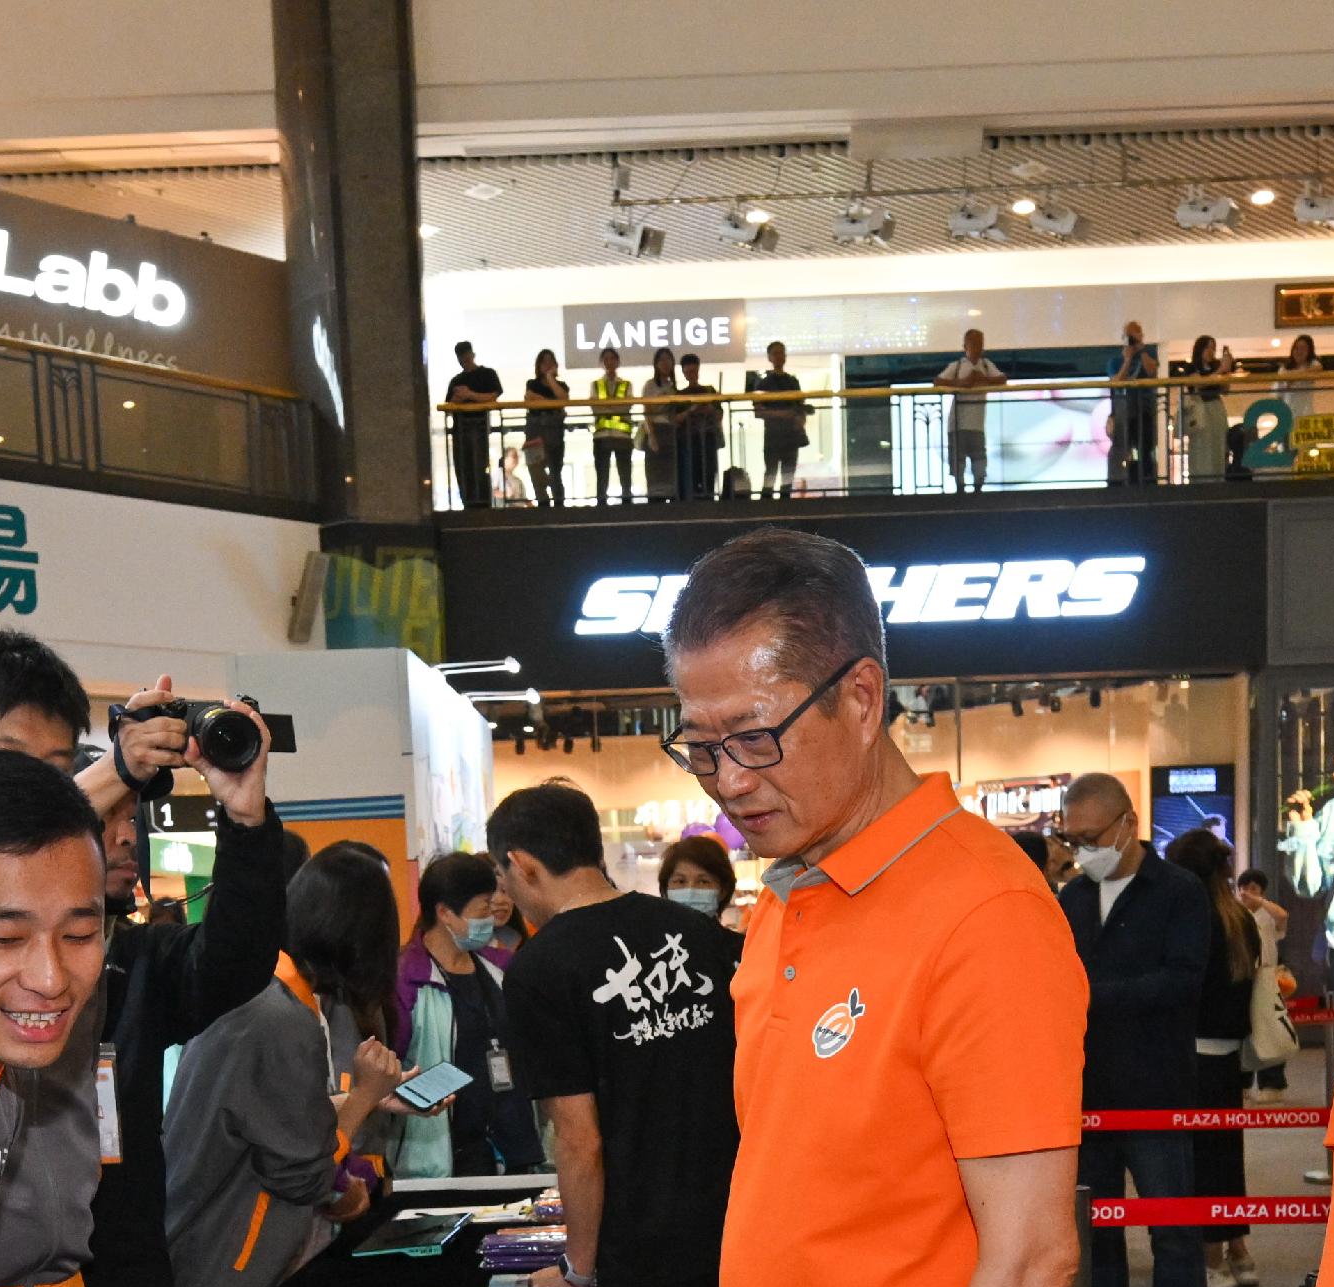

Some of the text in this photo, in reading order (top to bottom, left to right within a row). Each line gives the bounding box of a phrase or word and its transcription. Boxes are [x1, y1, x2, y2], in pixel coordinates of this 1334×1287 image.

[576, 317, 731, 350] LANEIGE
[574, 556, 1146, 635] SHERS
[1172, 1111, 1320, 1126] PLAZA HOLLYWOOD
[1211, 1202, 1330, 1218] PLAZA HOLLY
